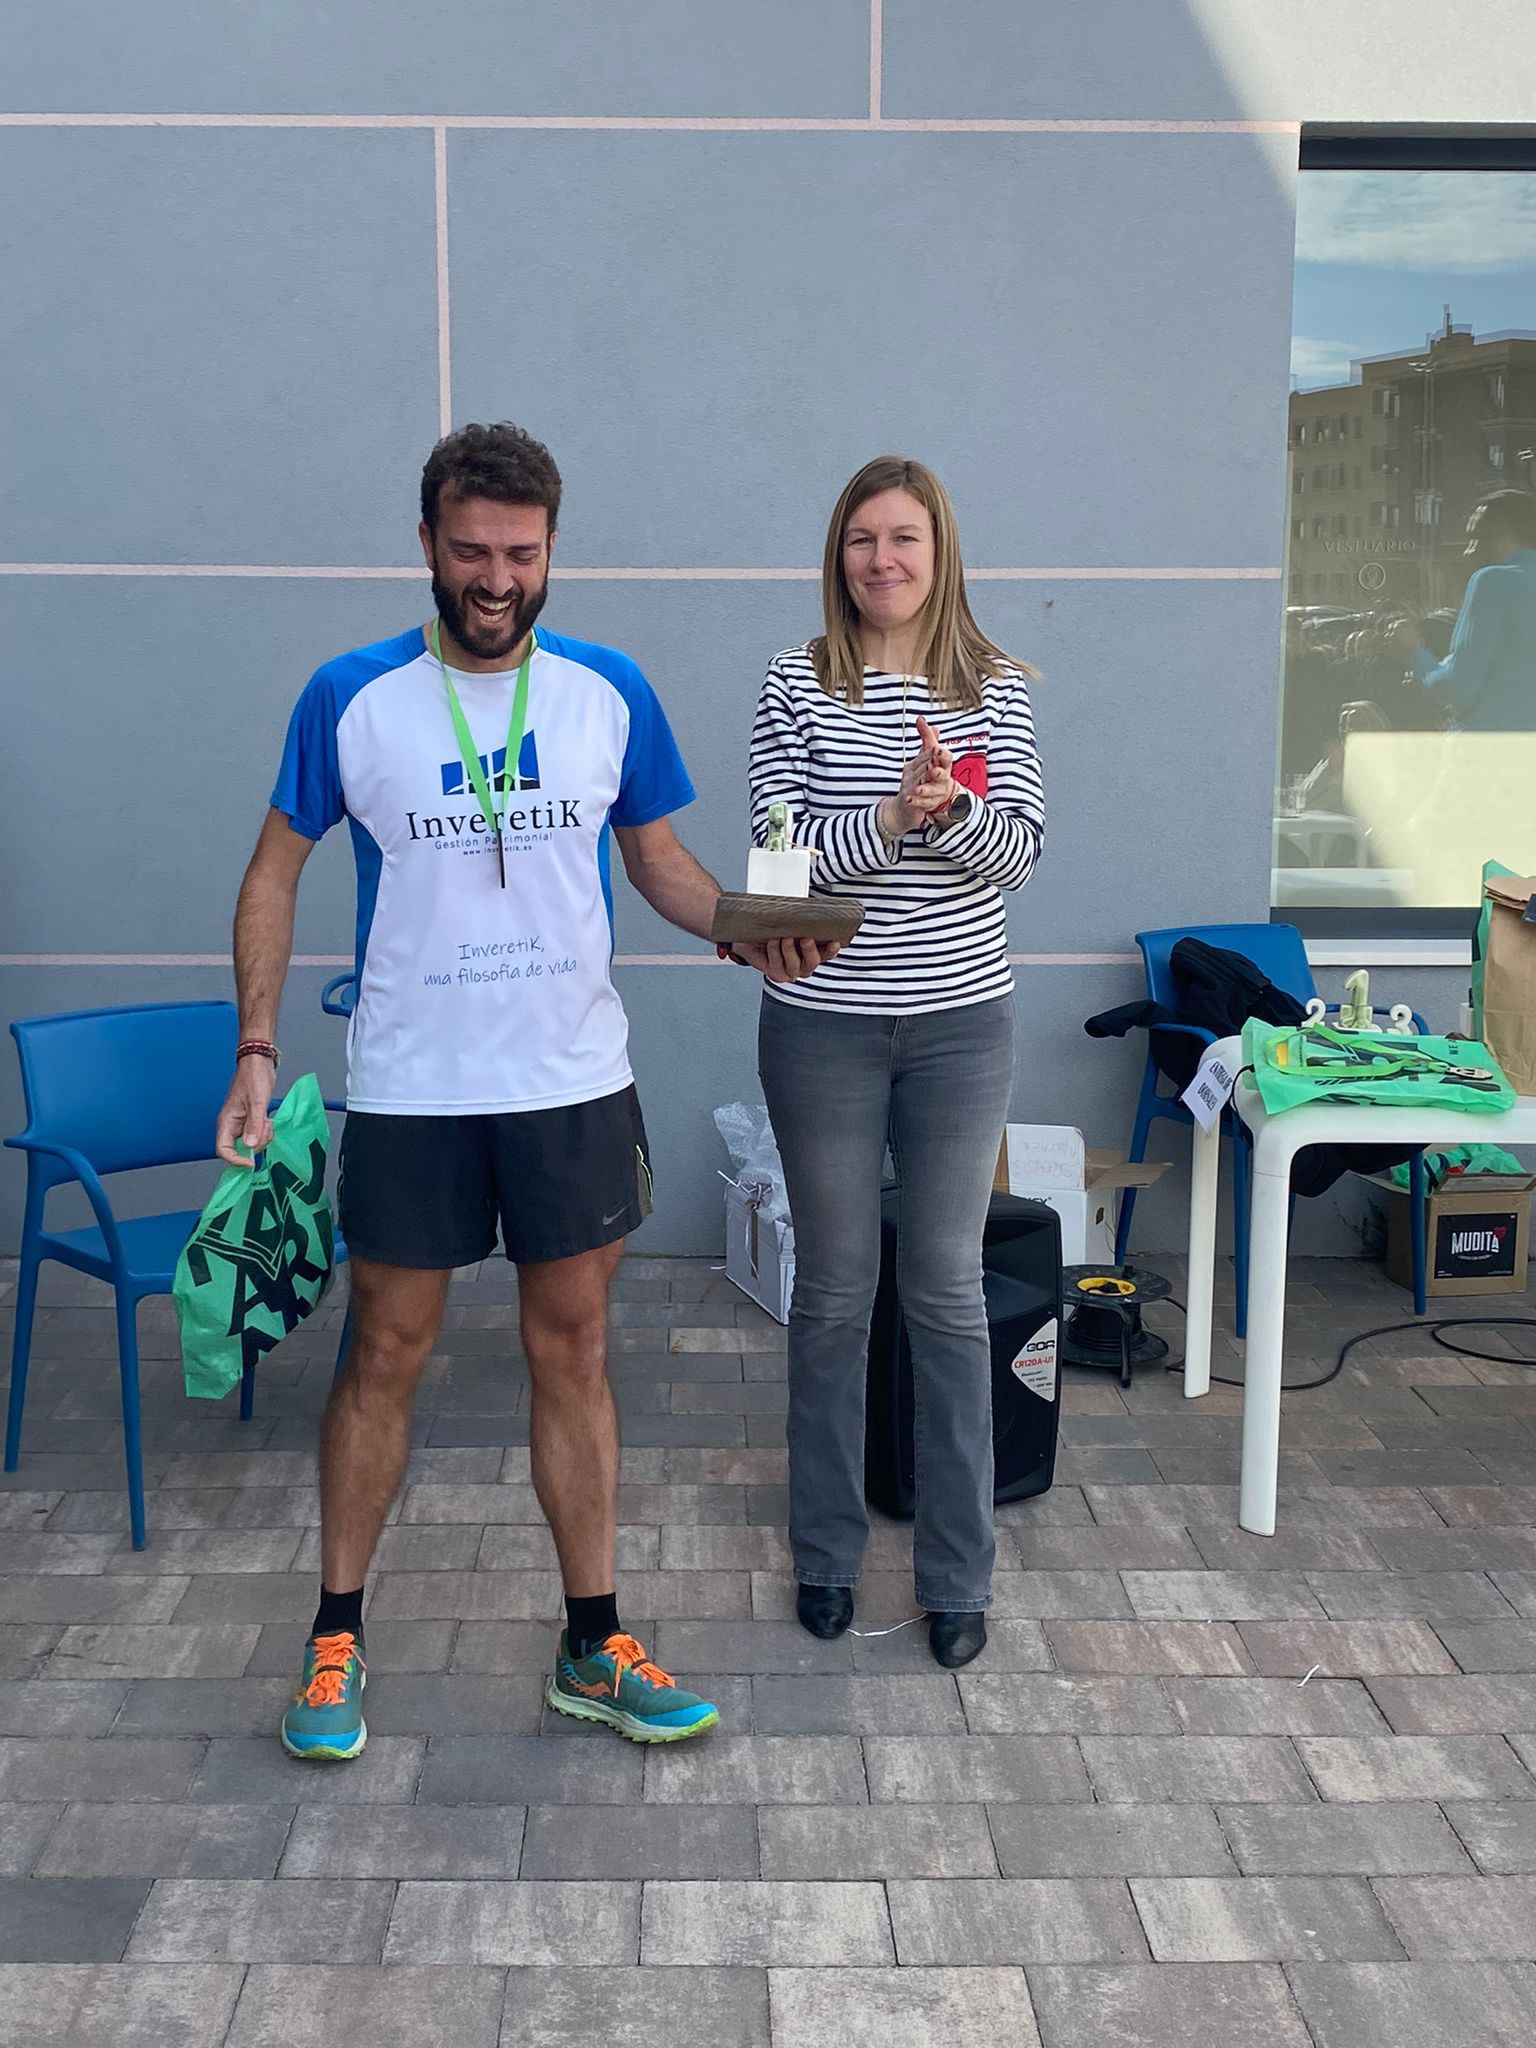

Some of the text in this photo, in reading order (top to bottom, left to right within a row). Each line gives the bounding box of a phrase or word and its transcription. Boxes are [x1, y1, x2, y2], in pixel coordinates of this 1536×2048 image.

[405, 799, 582, 840] InveretiK
[434, 831, 553, 850] Gestión Parimonial
[423, 956, 577, 986] una filosofía de vida
[1450, 1230, 1500, 1255] MUDITA
